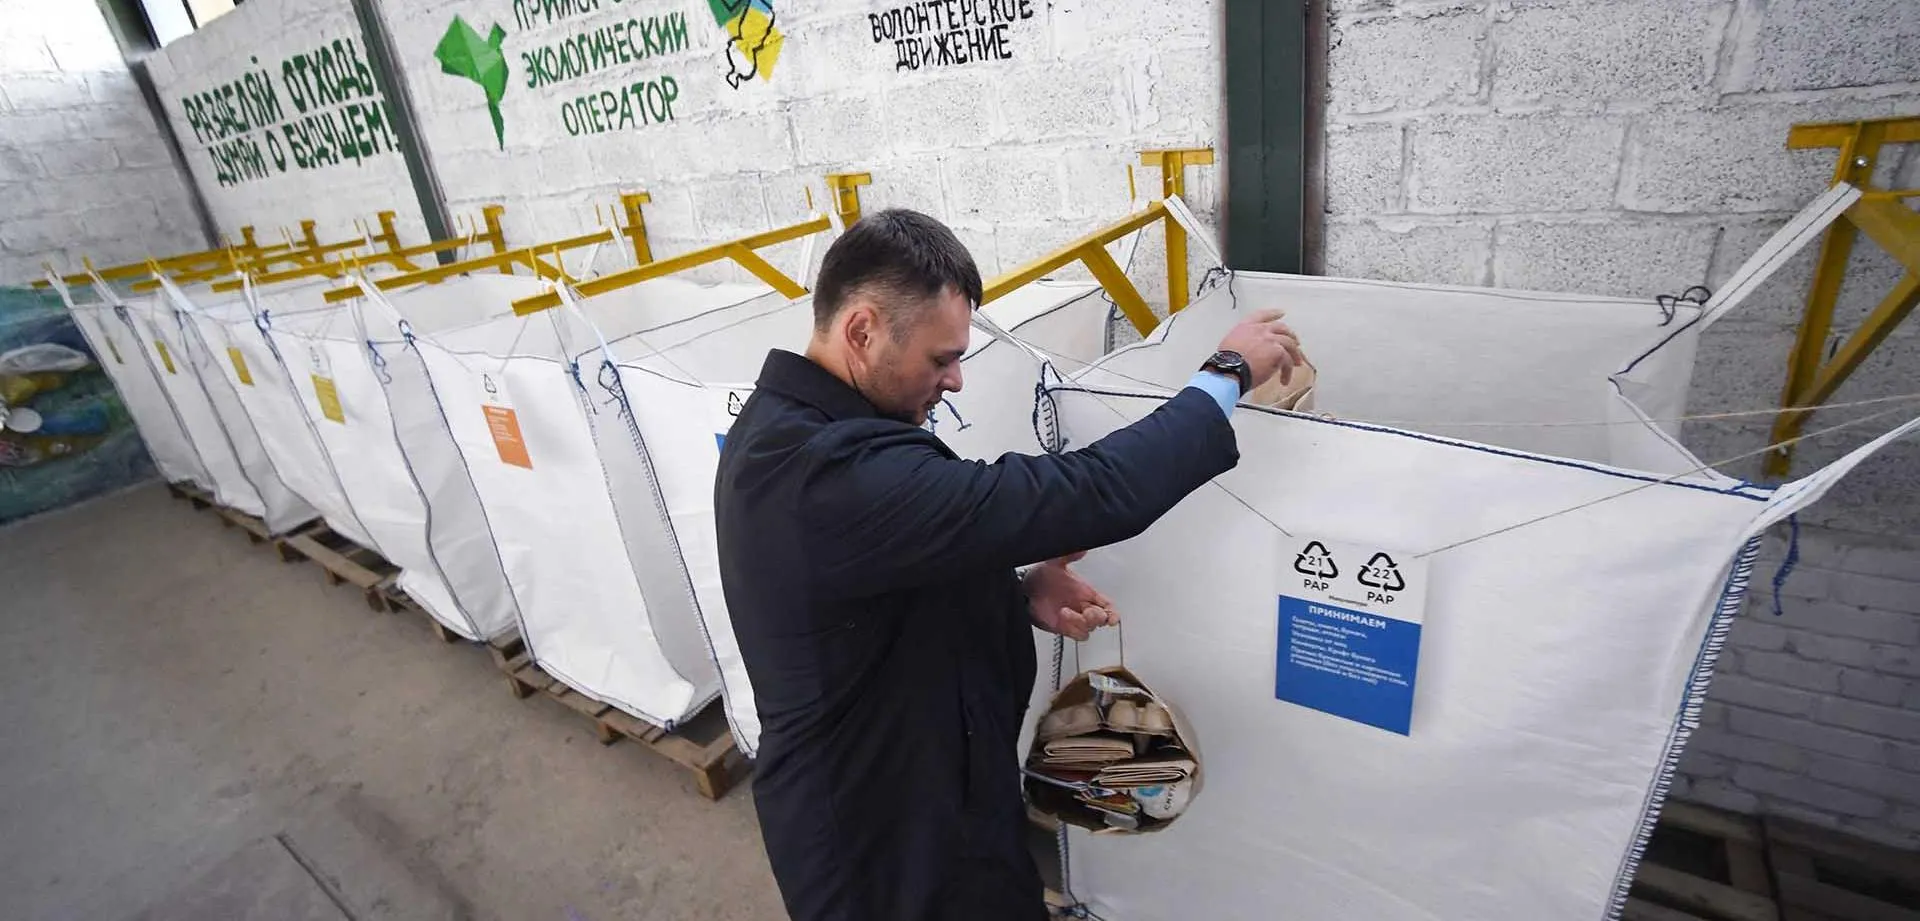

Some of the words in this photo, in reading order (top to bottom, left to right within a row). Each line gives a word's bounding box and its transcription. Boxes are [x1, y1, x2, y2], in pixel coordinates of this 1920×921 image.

[868, 0, 1034, 43] ВОЛОНТЕРСКОЕ
[521, 11, 690, 89] ЭКОЛОГИЧЕСКИЙ
[895, 24, 1012, 73] ДВИЖЕНИЕ
[182, 55, 284, 144] РАЗДЕЛЯЙ
[562, 75, 679, 137] ОПЕРАТОР
[208, 134, 270, 188] ДУМАЙ
[266, 130, 287, 173] О
[1308, 555, 1323, 567] 21
[1373, 567, 1391, 580] 22
[1303, 578, 1330, 592] PAP
[1367, 591, 1395, 605] PAP
[1308, 605, 1387, 629] ПРИНИМАЕМ
